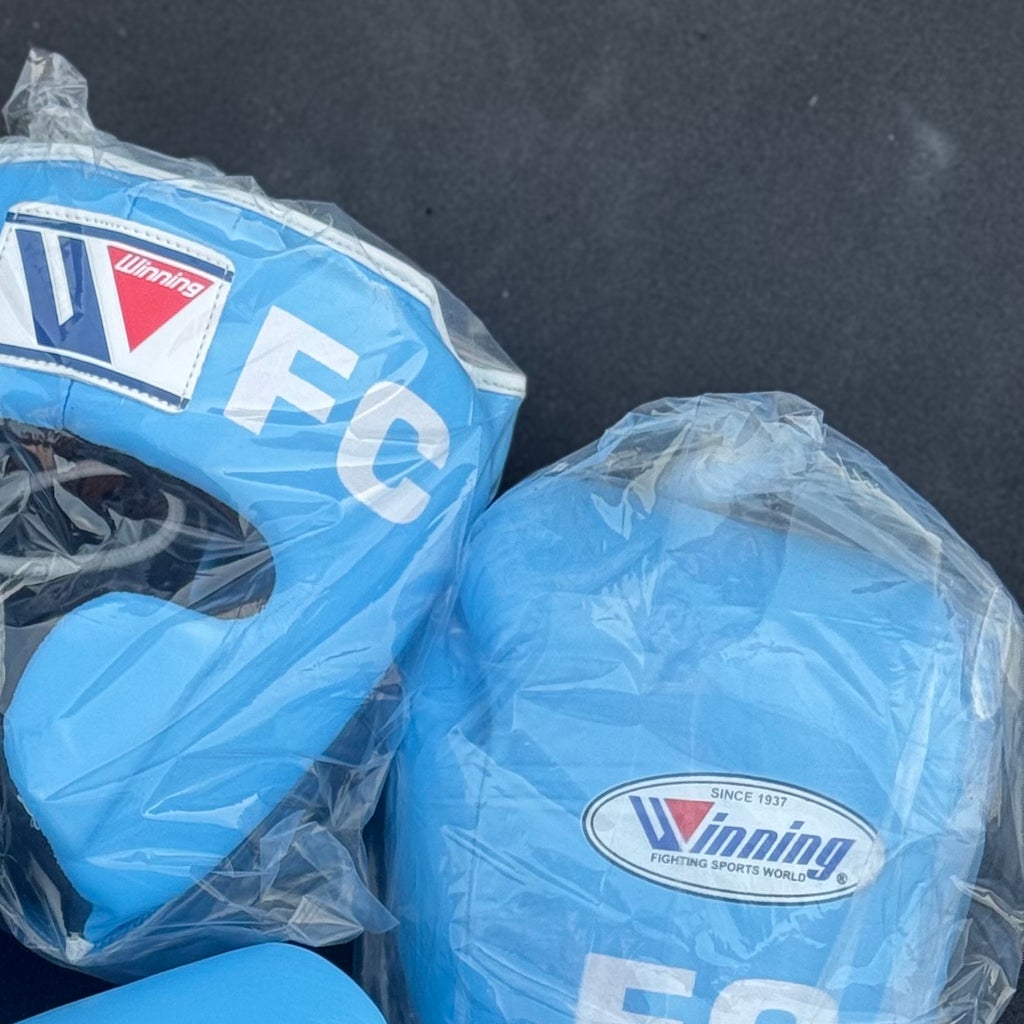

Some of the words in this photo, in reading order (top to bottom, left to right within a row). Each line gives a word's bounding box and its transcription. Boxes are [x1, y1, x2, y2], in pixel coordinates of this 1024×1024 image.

[114, 252, 205, 299] Winning
[223, 305, 450, 524] FC
[710, 787, 753, 804] SINCE
[758, 793, 787, 808] 1937
[628, 795, 857, 881] Winning
[650, 852, 708, 870] FIGHTING
[711, 860, 760, 877] SPORTS
[762, 866, 807, 883] WORLD
